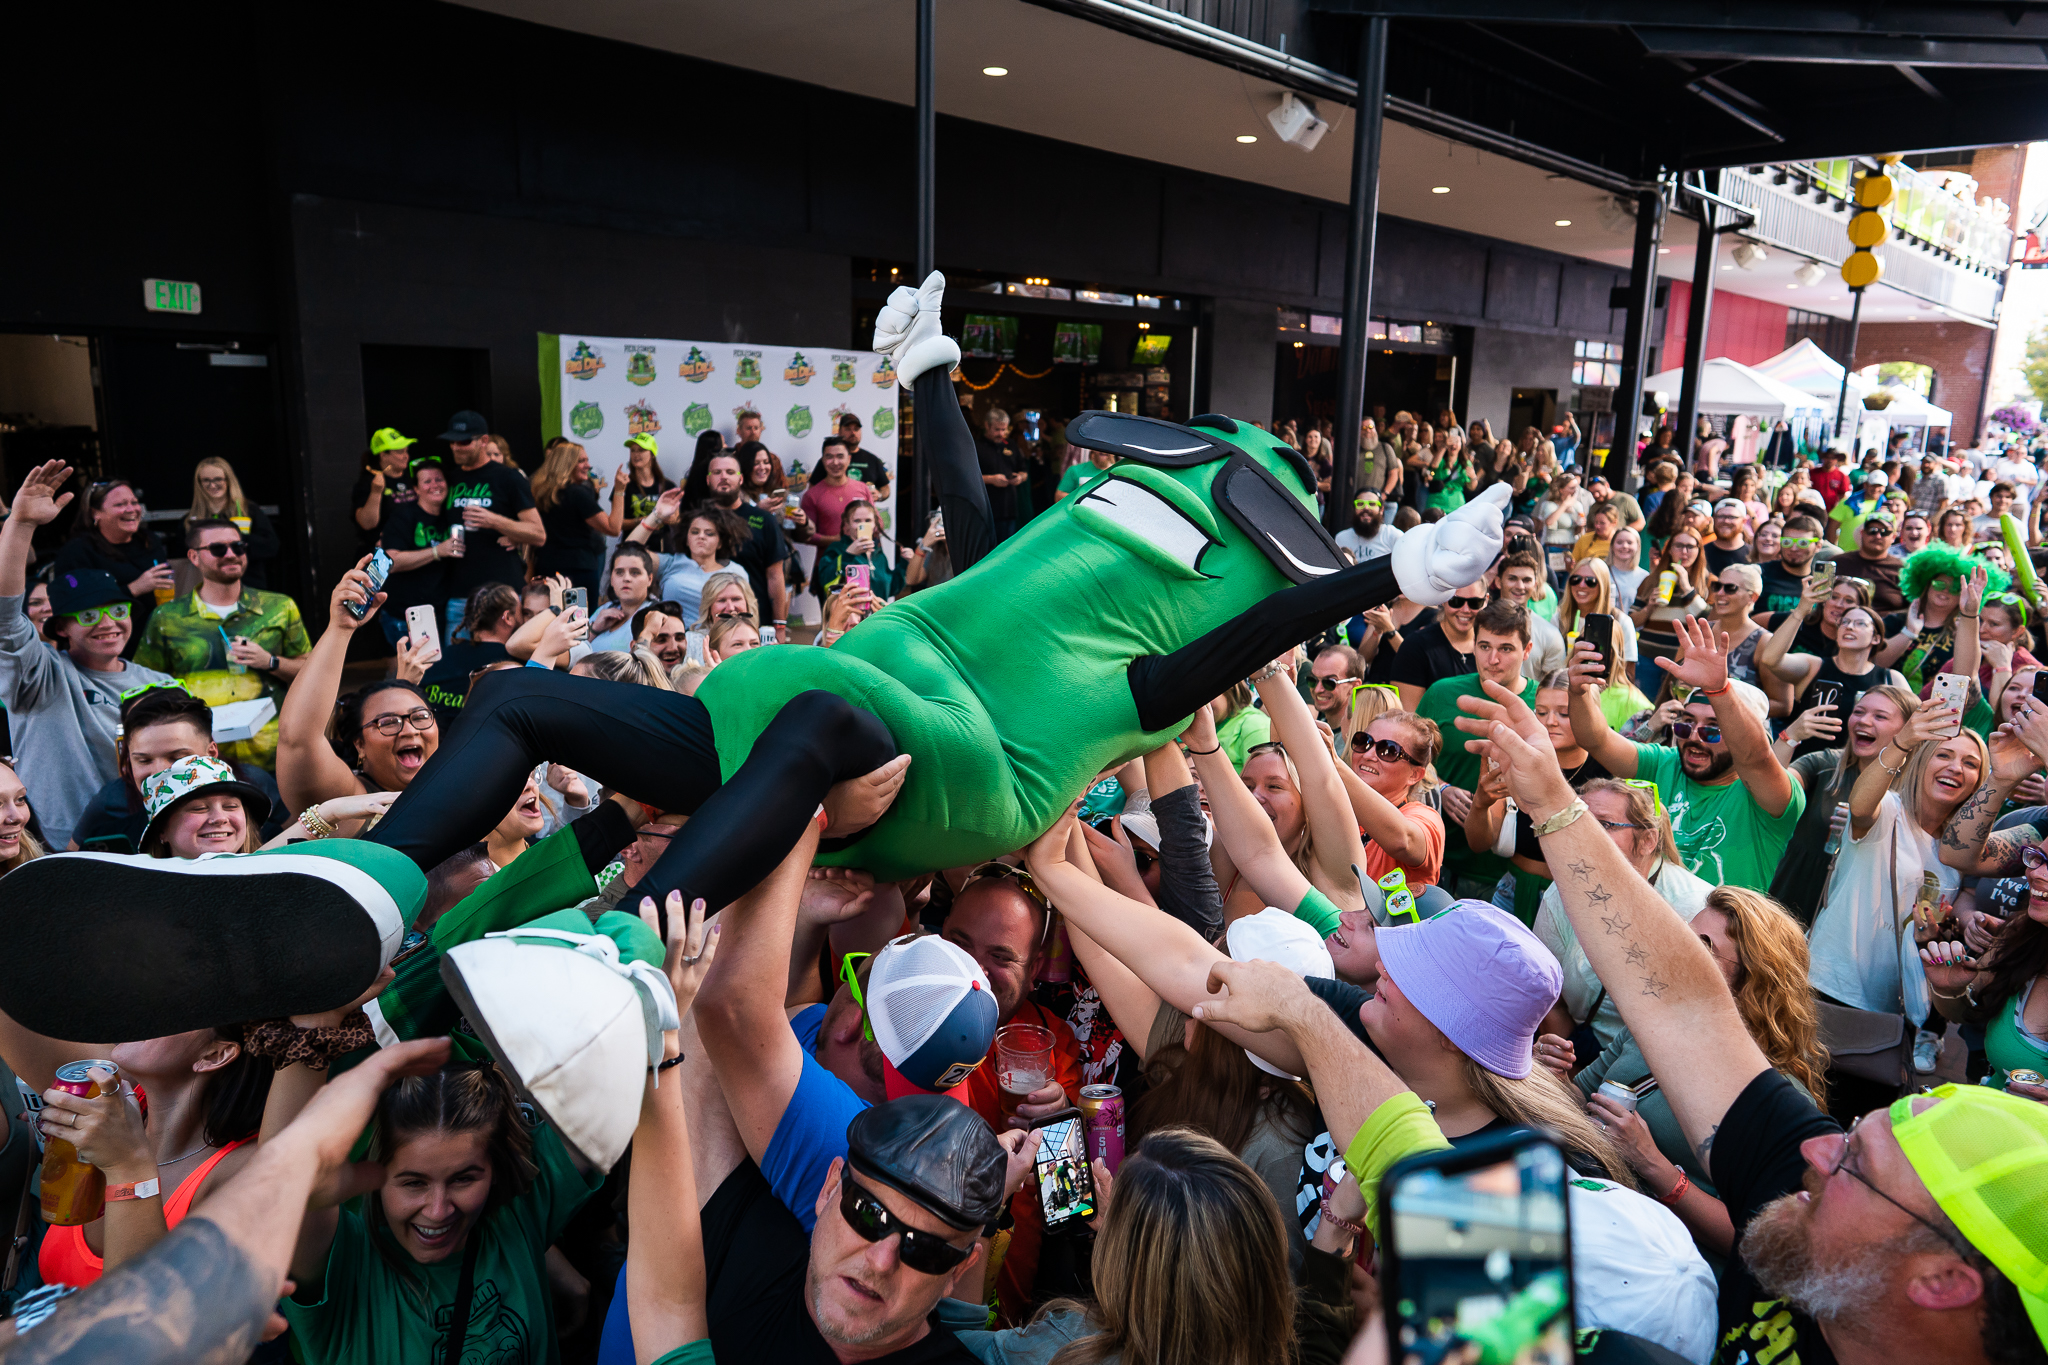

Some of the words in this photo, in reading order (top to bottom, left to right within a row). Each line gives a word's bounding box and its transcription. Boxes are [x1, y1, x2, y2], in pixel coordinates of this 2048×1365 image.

[155, 281, 192, 311] EXIT
[425, 685, 464, 708] Brea
[1996, 878, 2023, 893] I've
[1990, 887, 2017, 906] I've
[42, 1191, 60, 1200] PEACH
